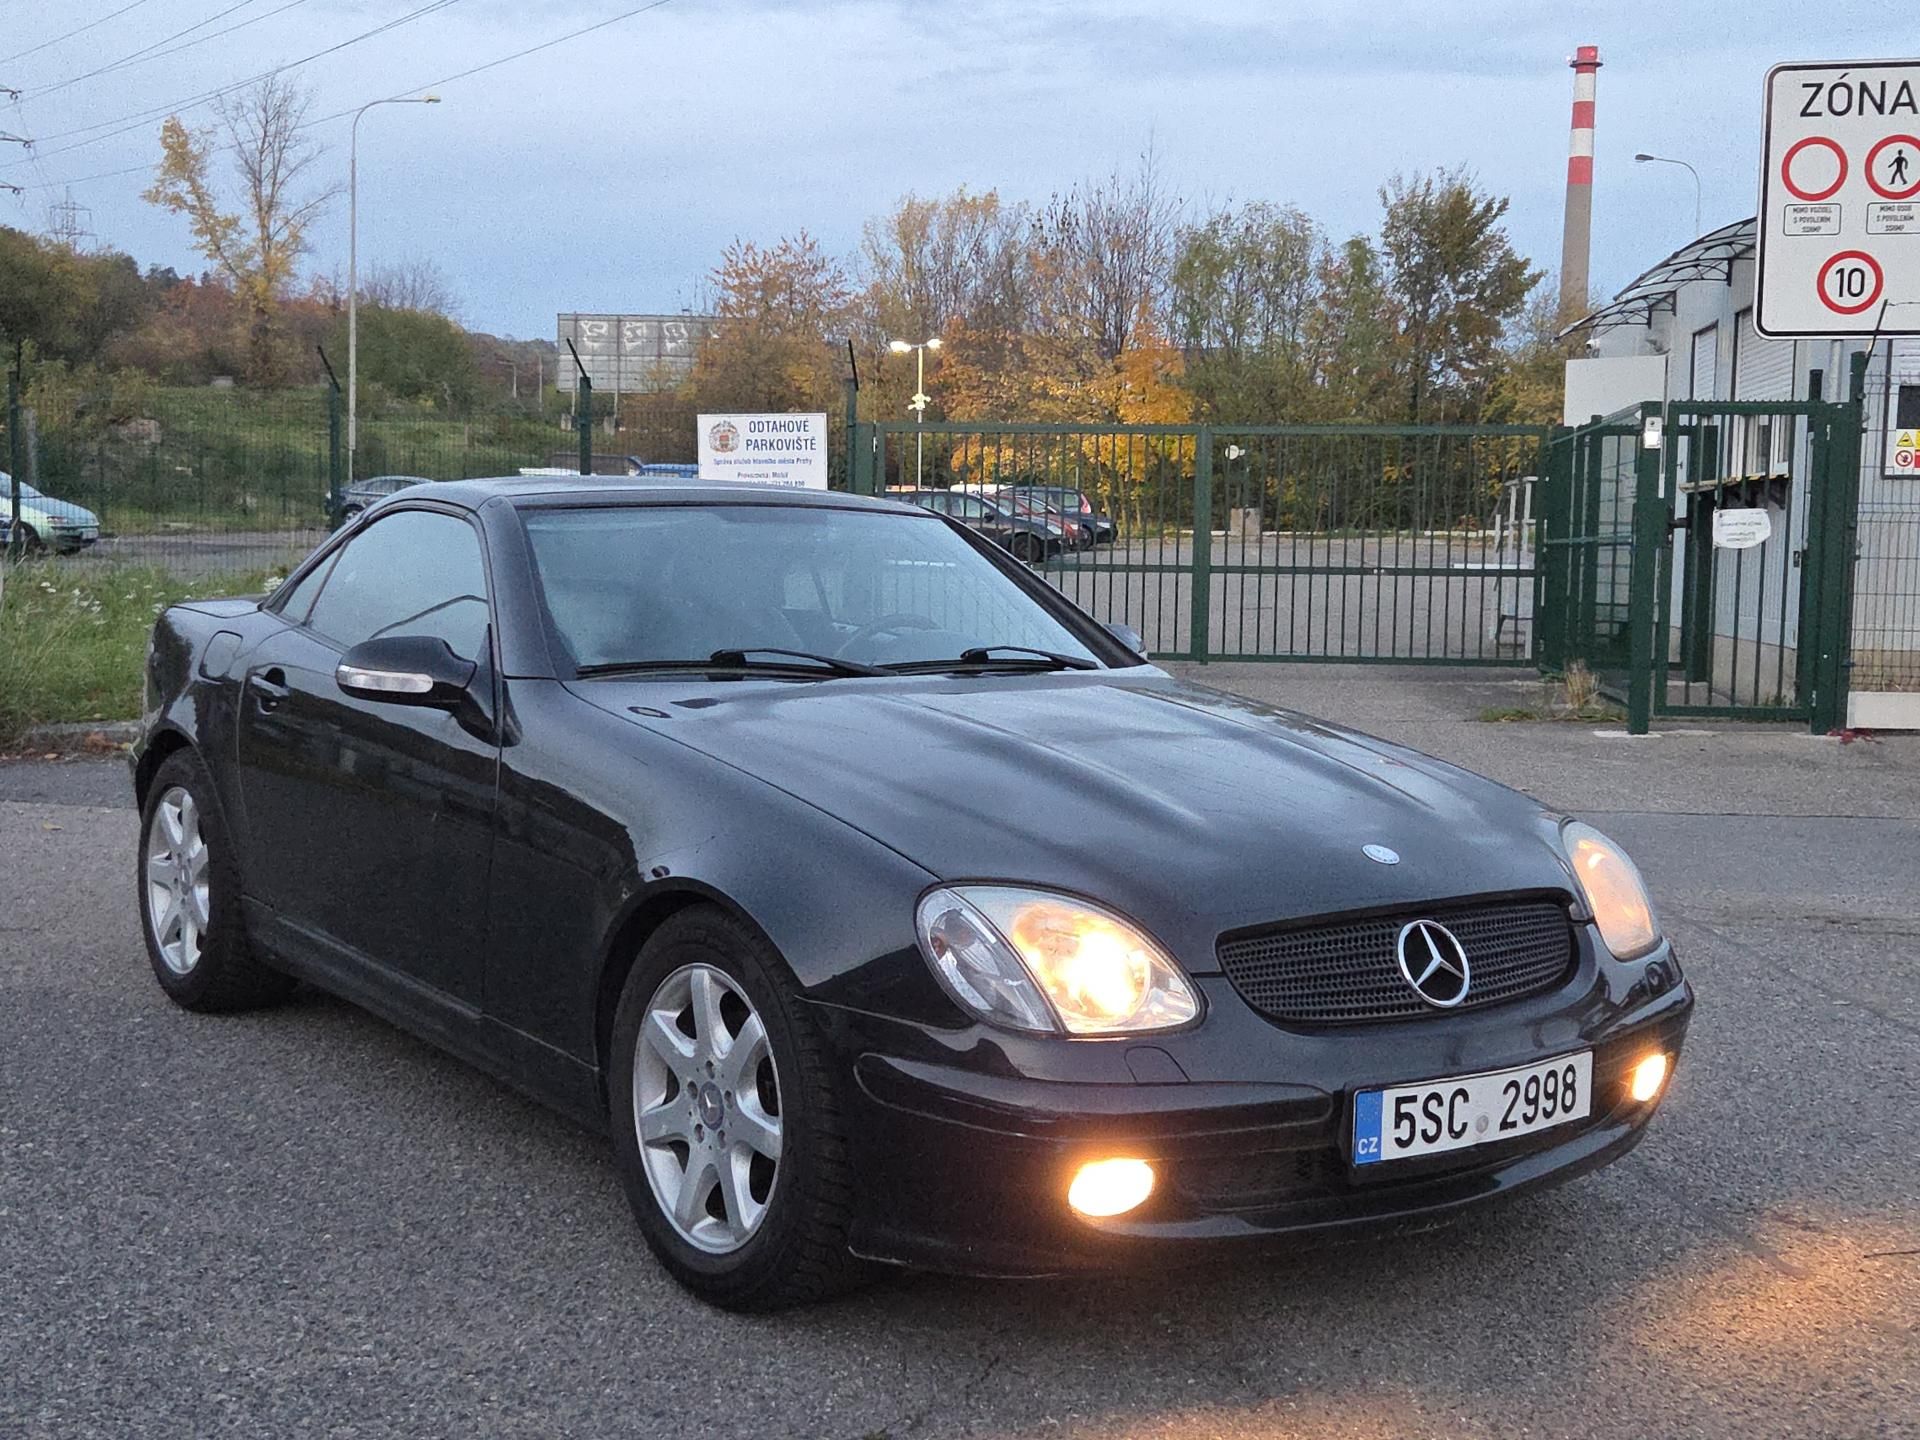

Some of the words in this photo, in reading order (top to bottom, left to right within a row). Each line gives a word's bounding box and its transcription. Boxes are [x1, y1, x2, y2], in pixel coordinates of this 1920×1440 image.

[1799, 72, 1919, 117] ZÓNA
[1835, 267, 1865, 298] 10
[749, 417, 810, 433] ODTAHOVÉ
[746, 435, 817, 451] PARKOVIŠTĚ
[1393, 1088, 1470, 1148] 5SC
[1499, 1063, 1577, 1132] 2998
[1357, 1136, 1378, 1155] CZ
